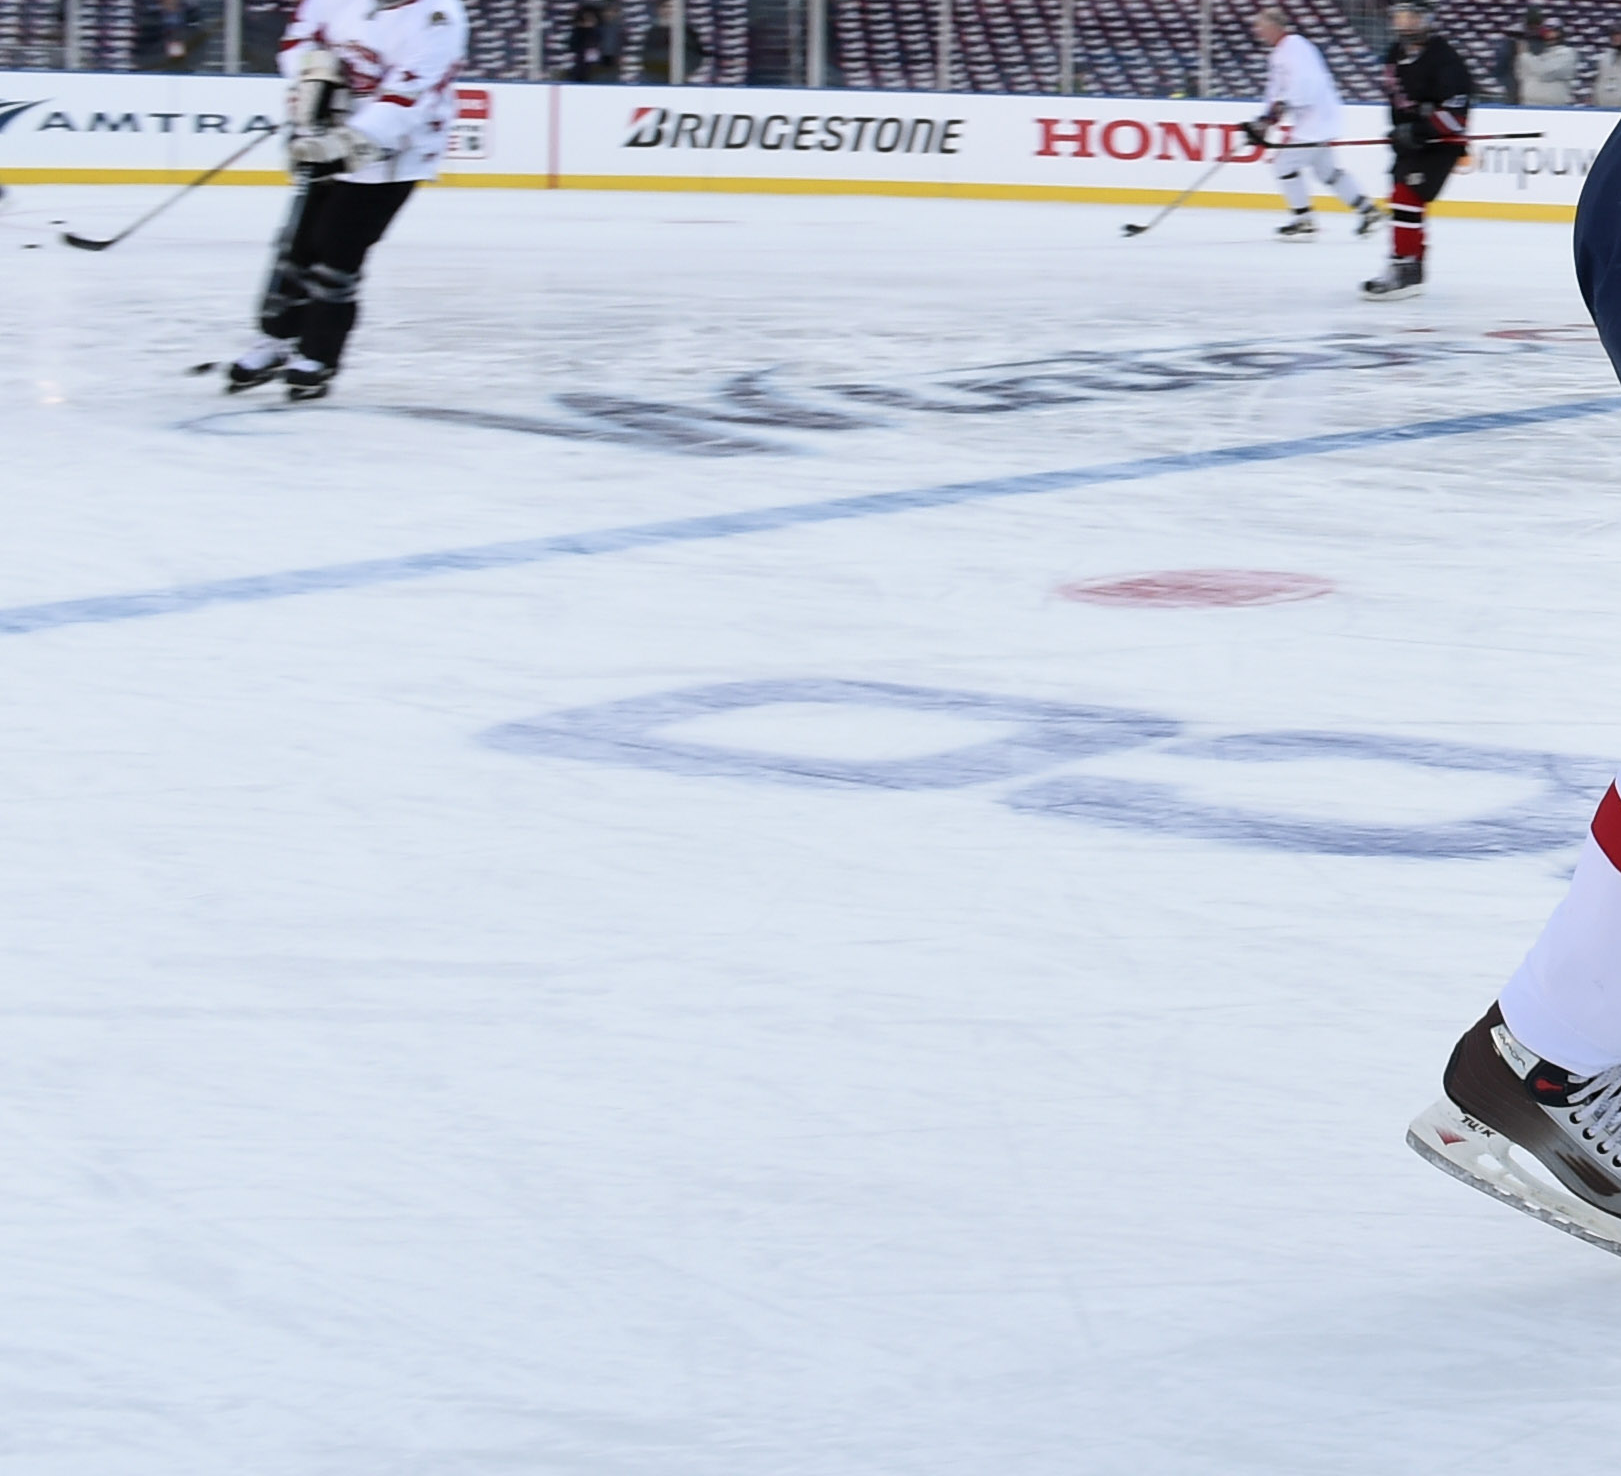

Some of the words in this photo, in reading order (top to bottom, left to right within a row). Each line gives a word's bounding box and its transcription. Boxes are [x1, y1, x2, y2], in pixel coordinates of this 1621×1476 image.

[37, 110, 287, 135] AMTRA
[625, 105, 966, 157] BRIDGESTONE
[1033, 117, 1291, 164] HOND
